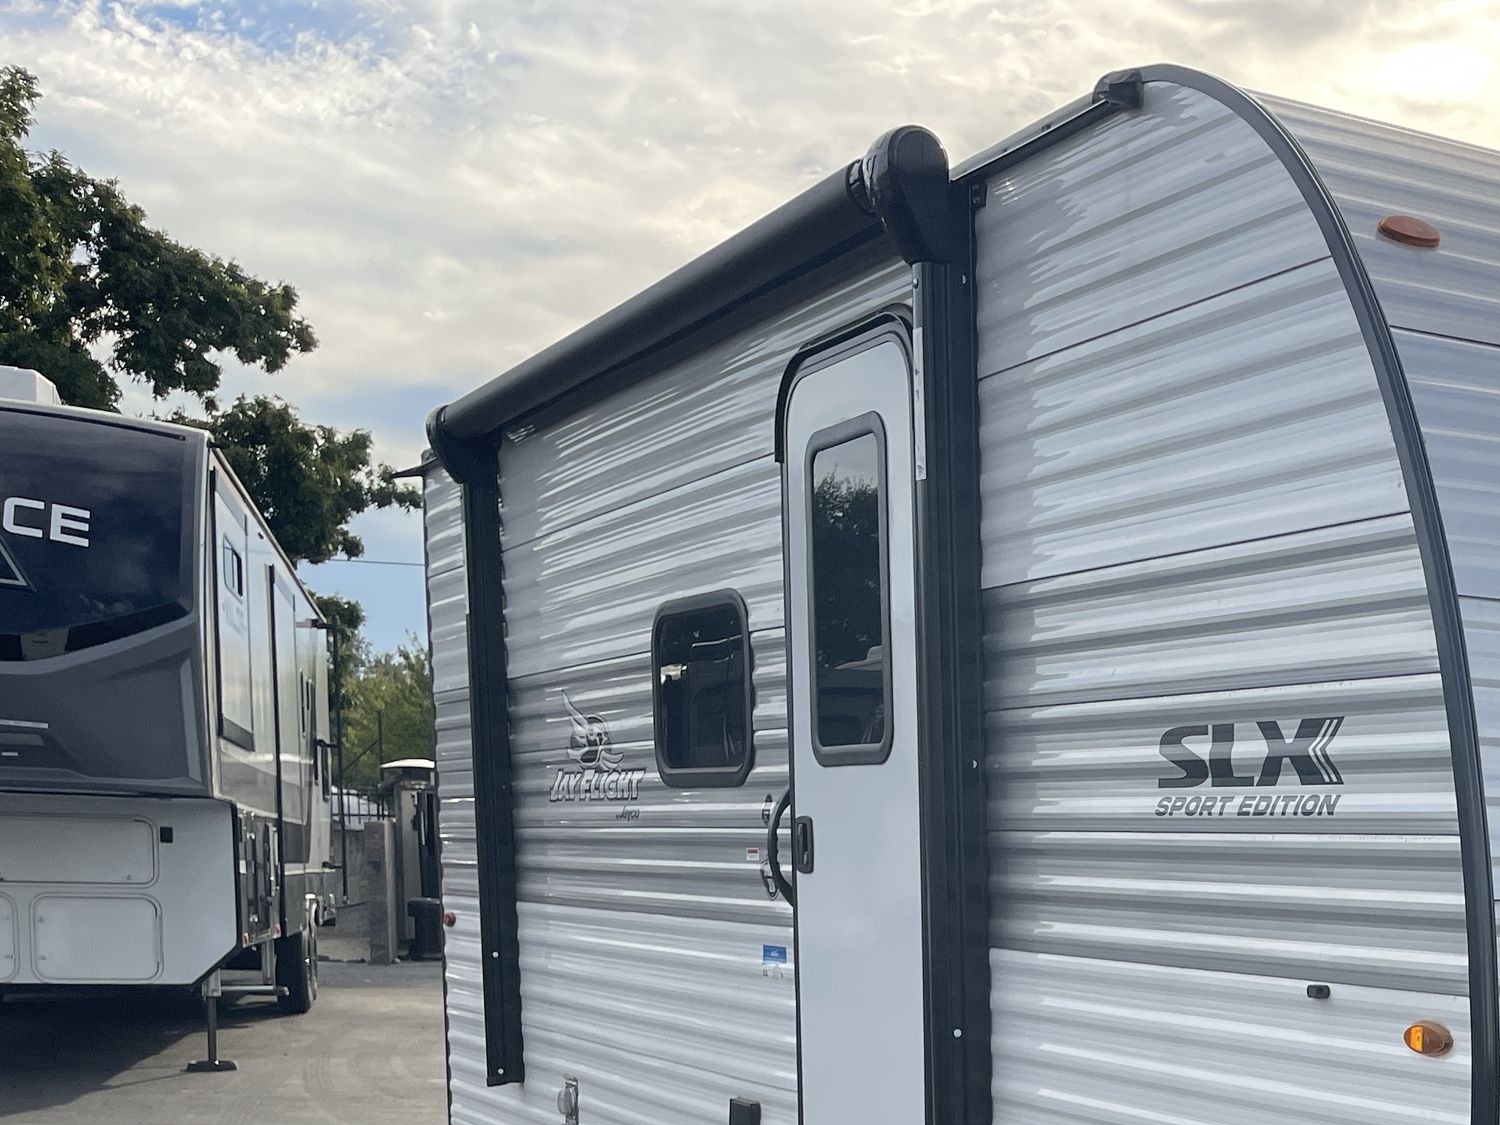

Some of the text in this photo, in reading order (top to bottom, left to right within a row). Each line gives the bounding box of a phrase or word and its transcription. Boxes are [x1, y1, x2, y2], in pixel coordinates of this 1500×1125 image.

[1157, 716, 1345, 789] SLX
[549, 767, 646, 802] JAY FLIGHT
[1154, 794, 1342, 817] SPORT EDITION
